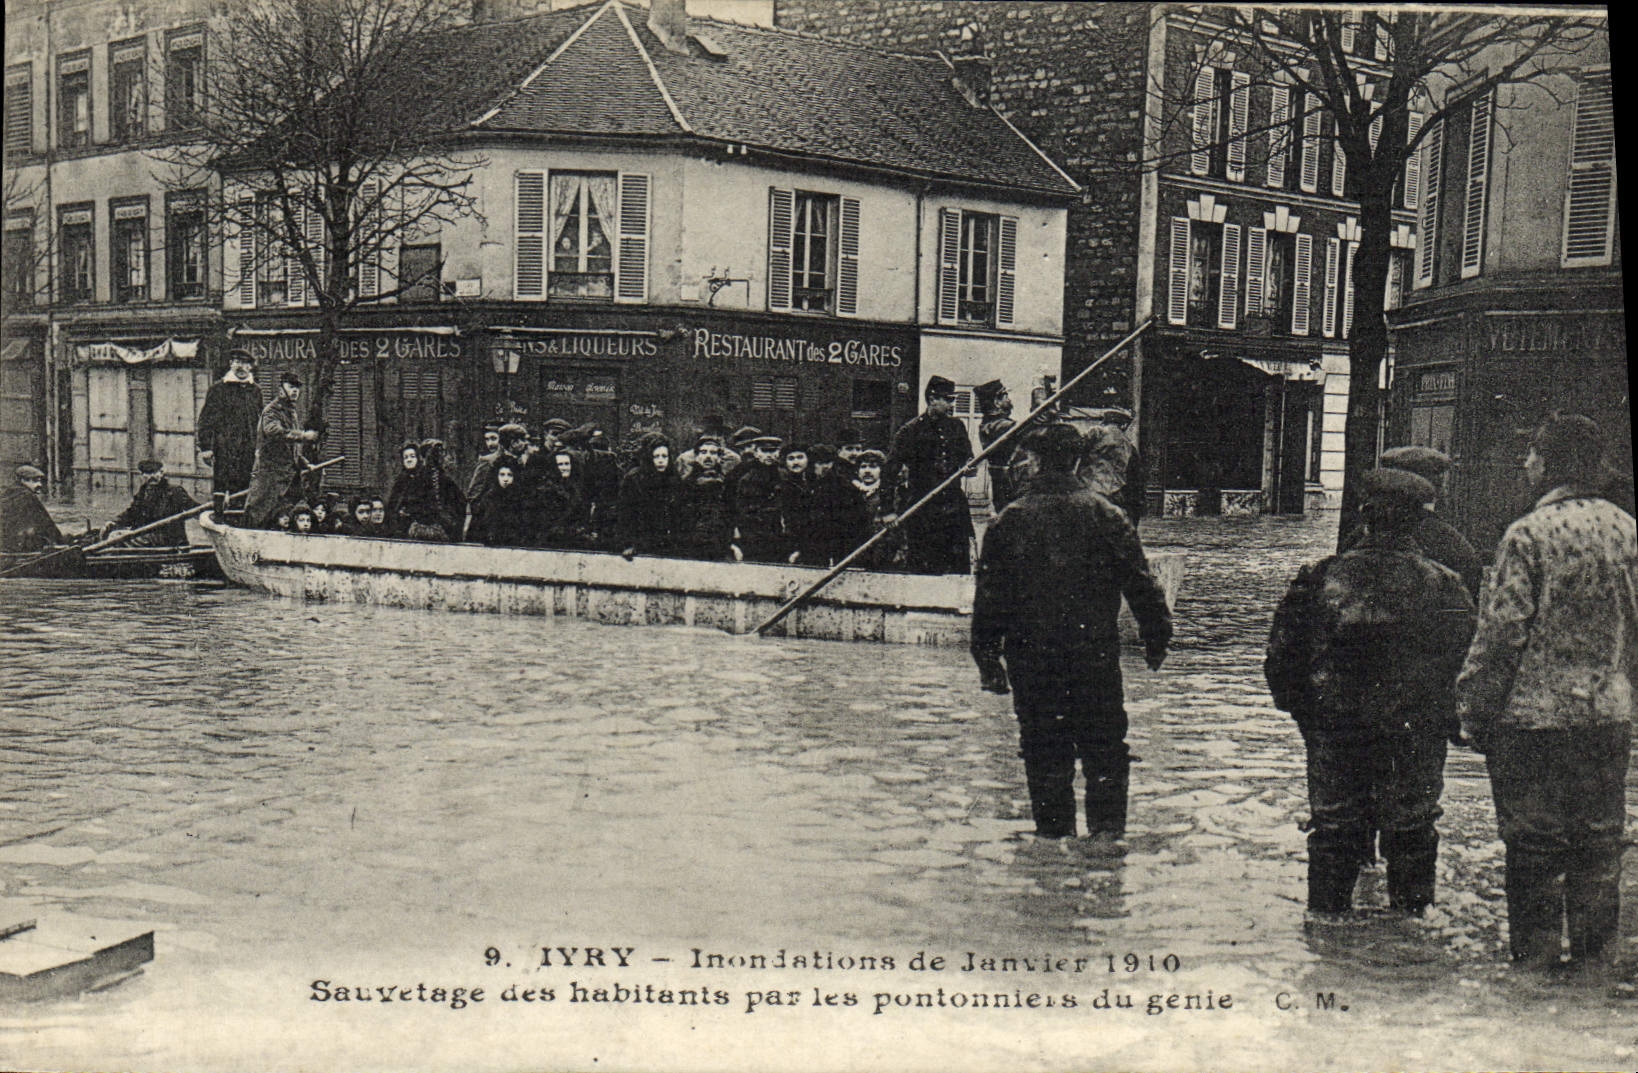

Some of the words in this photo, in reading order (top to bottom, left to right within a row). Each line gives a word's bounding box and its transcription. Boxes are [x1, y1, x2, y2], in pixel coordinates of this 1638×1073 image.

[242, 337, 318, 360] RESTAURA
[340, 340, 369, 358] DES
[376, 337, 390, 359] 2
[395, 336, 462, 359] GARES
[562, 336, 658, 356] LIQUEURS
[693, 328, 806, 361] RESTAURANT
[807, 342, 825, 363] des
[828, 342, 842, 364] 2
[845, 340, 902, 367] GARES
